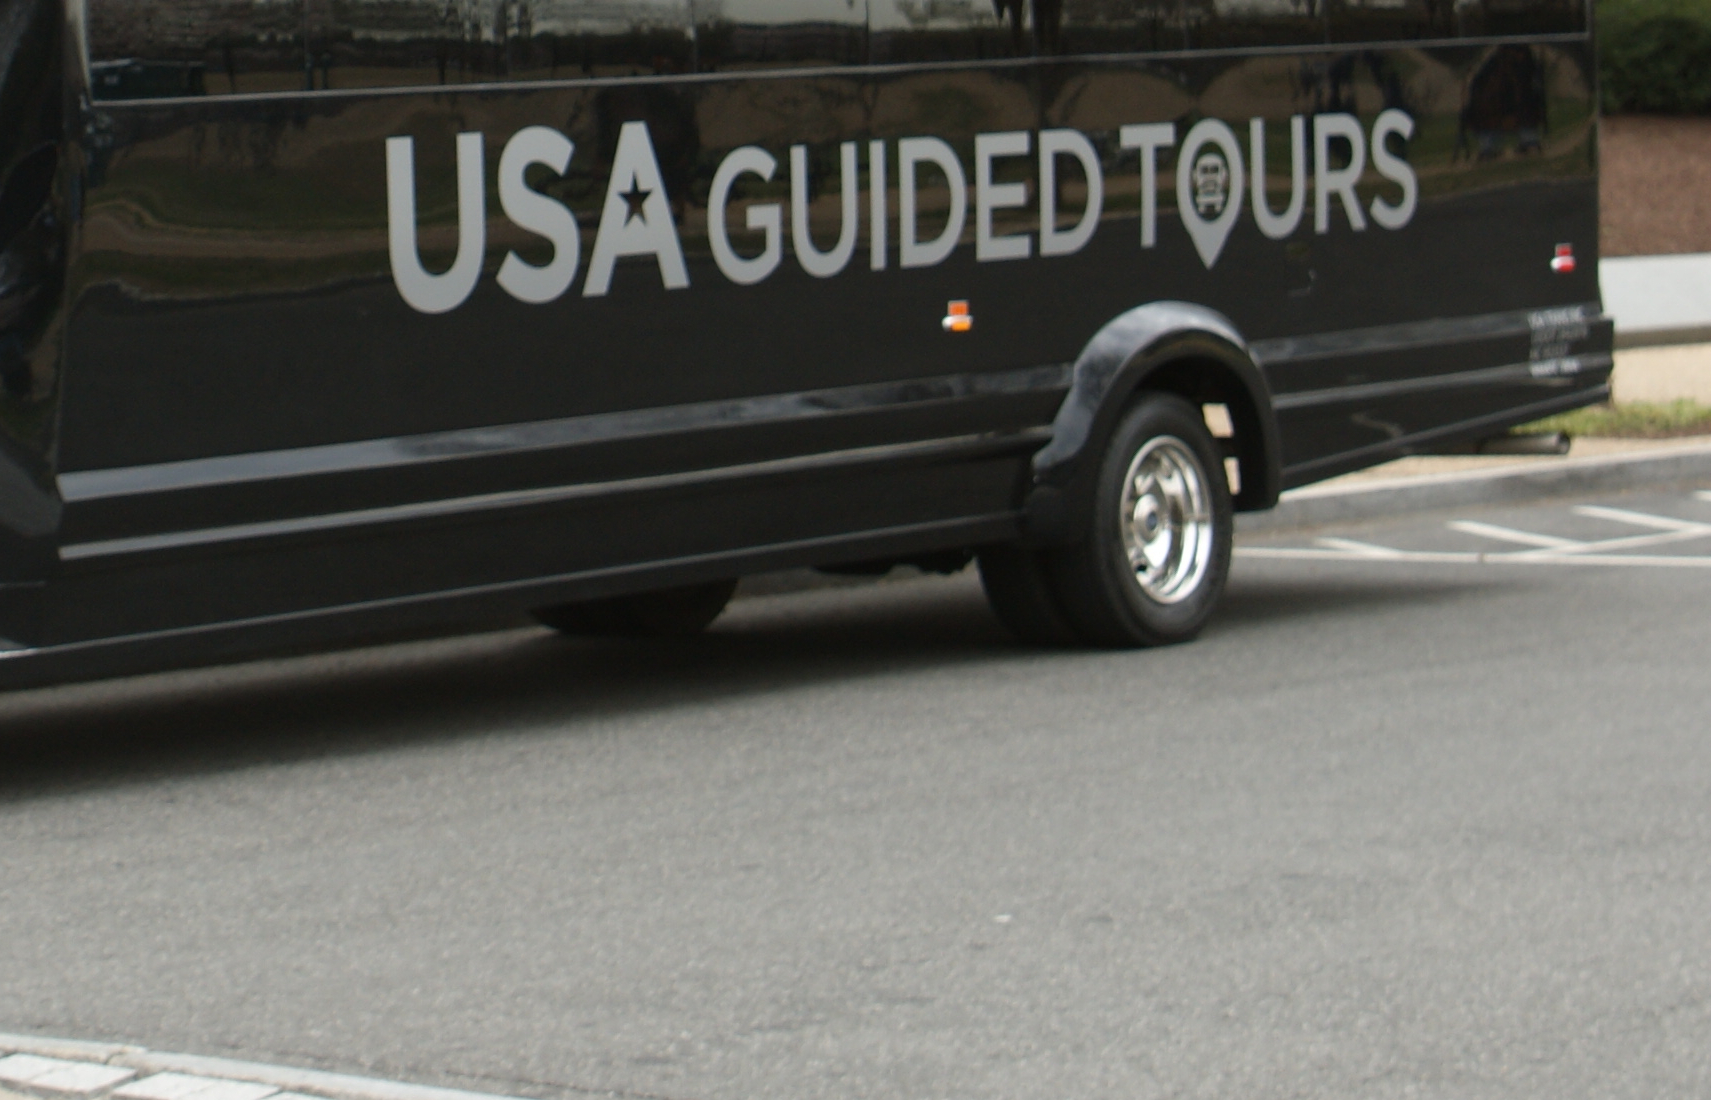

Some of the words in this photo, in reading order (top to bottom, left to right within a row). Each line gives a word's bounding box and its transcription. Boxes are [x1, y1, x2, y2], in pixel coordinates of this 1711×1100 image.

[385, 121, 689, 314] USA
[706, 128, 1104, 285] GUIDED
[1119, 109, 1417, 269] TOURS
